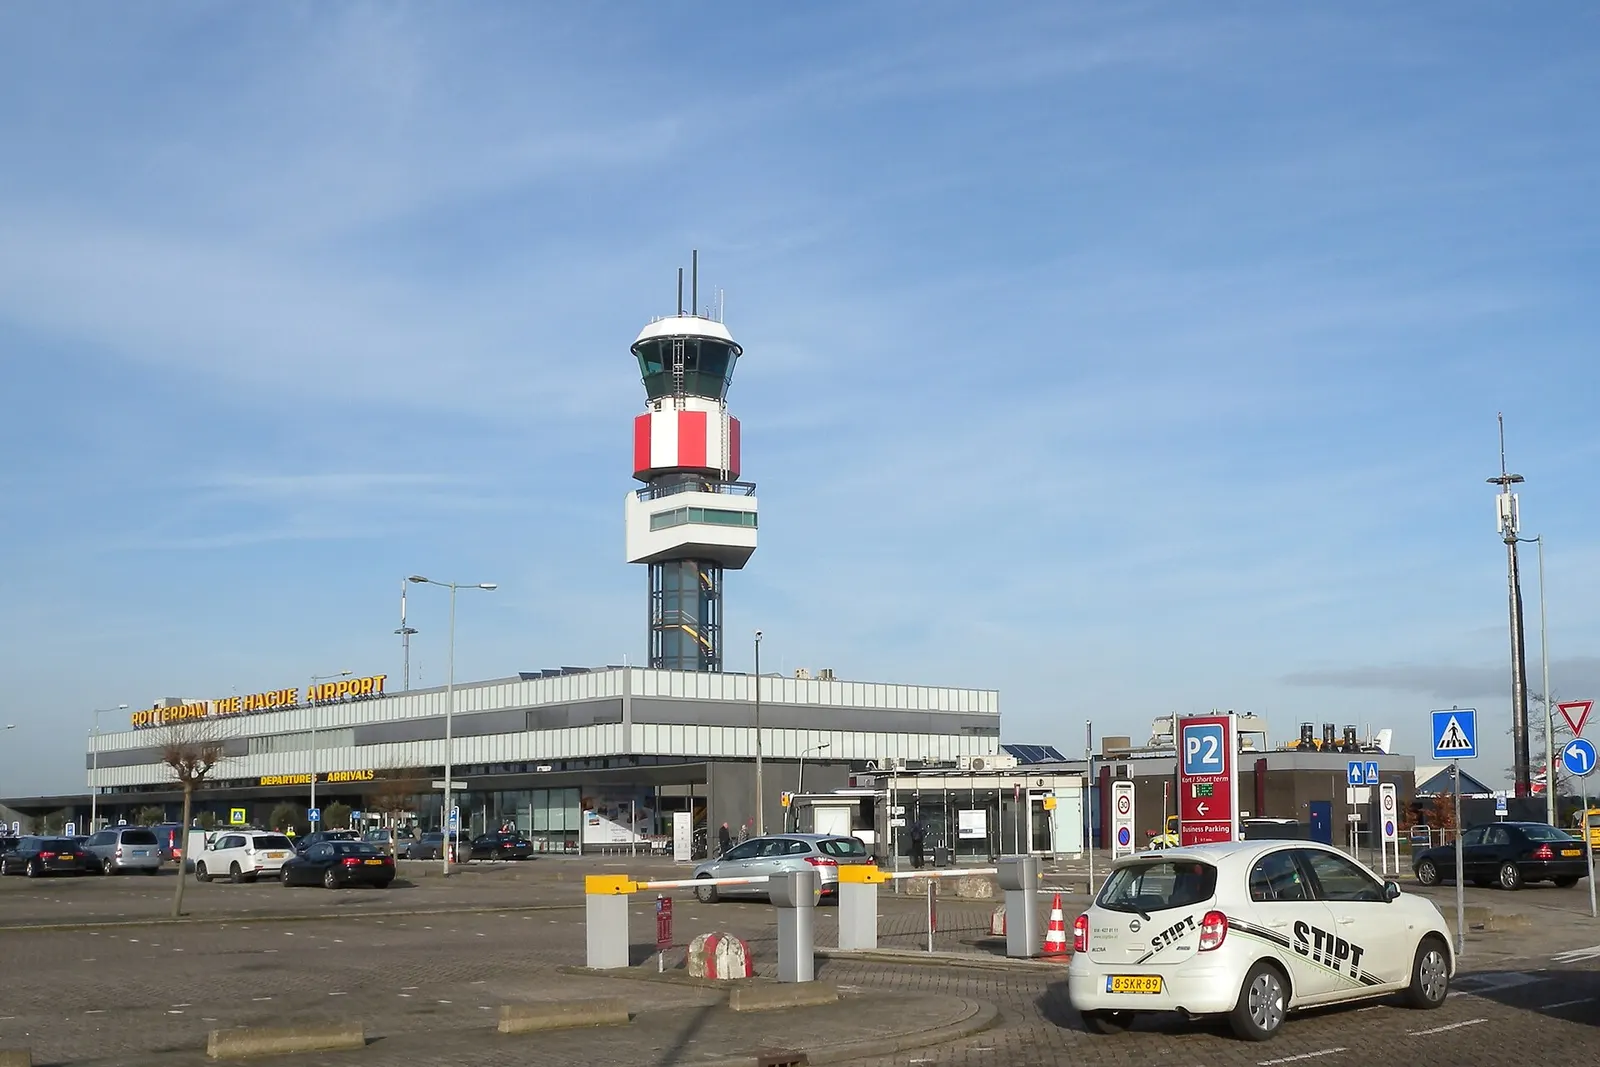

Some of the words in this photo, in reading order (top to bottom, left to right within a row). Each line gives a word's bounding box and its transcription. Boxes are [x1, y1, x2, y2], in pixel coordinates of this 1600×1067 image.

[131, 701, 209, 726] ROTTERDAM
[213, 696, 242, 715] THE
[244, 687, 298, 712] HAGUE
[306, 674, 387, 702] AIRPORT
[1186, 735, 1219, 765] P2
[327, 769, 374, 782] ARRIVALS
[1120, 801, 1128, 809] 30
[1182, 825, 1204, 833] Business
[1204, 825, 1230, 833] Parking
[1151, 915, 1196, 952] STIPT
[1293, 920, 1365, 980] STIPT
[1114, 978, 1158, 989] 8-SKR-89
